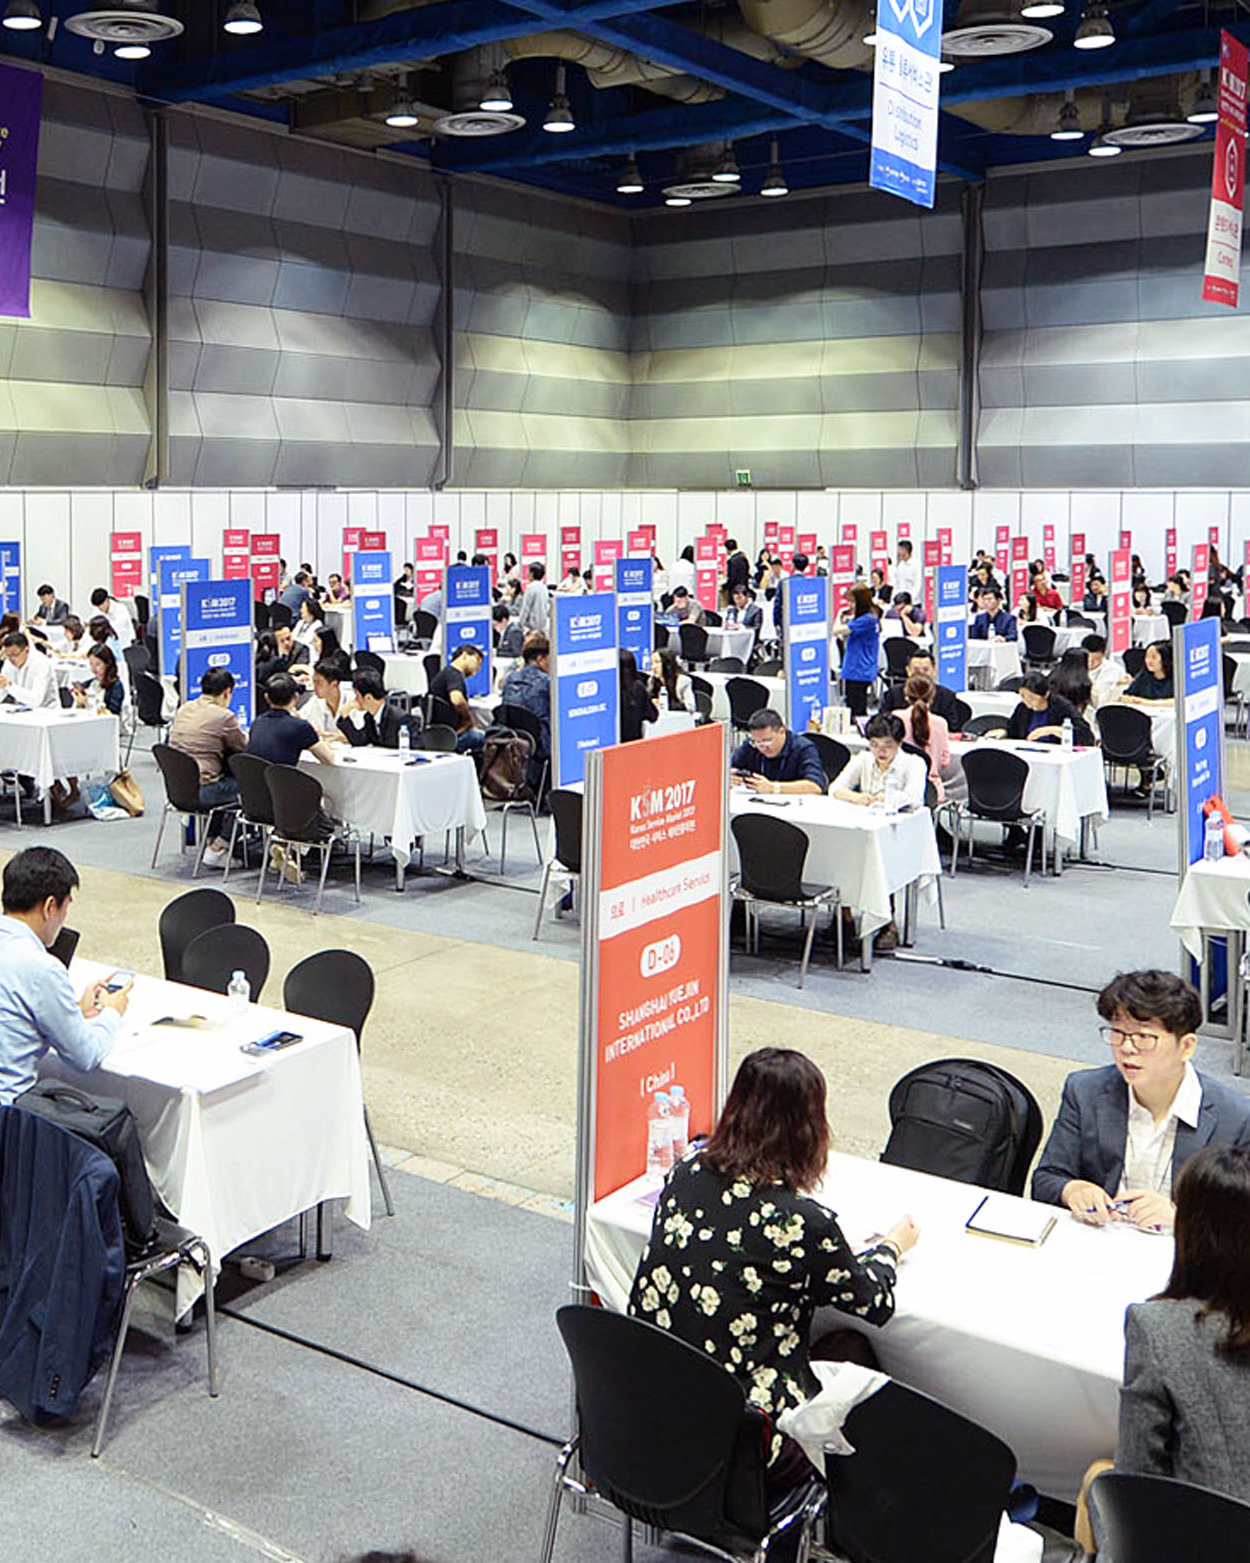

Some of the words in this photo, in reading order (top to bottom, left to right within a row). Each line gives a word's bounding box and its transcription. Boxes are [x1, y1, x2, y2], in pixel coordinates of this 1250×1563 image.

[630, 788, 664, 822] KSM
[665, 780, 696, 811] 2017
[647, 942, 676, 970] D-06
[618, 995, 668, 1030] SHANGHAI
[667, 978, 700, 1009] YUEJIN
[604, 1014, 676, 1063] INTERNATIONAL
